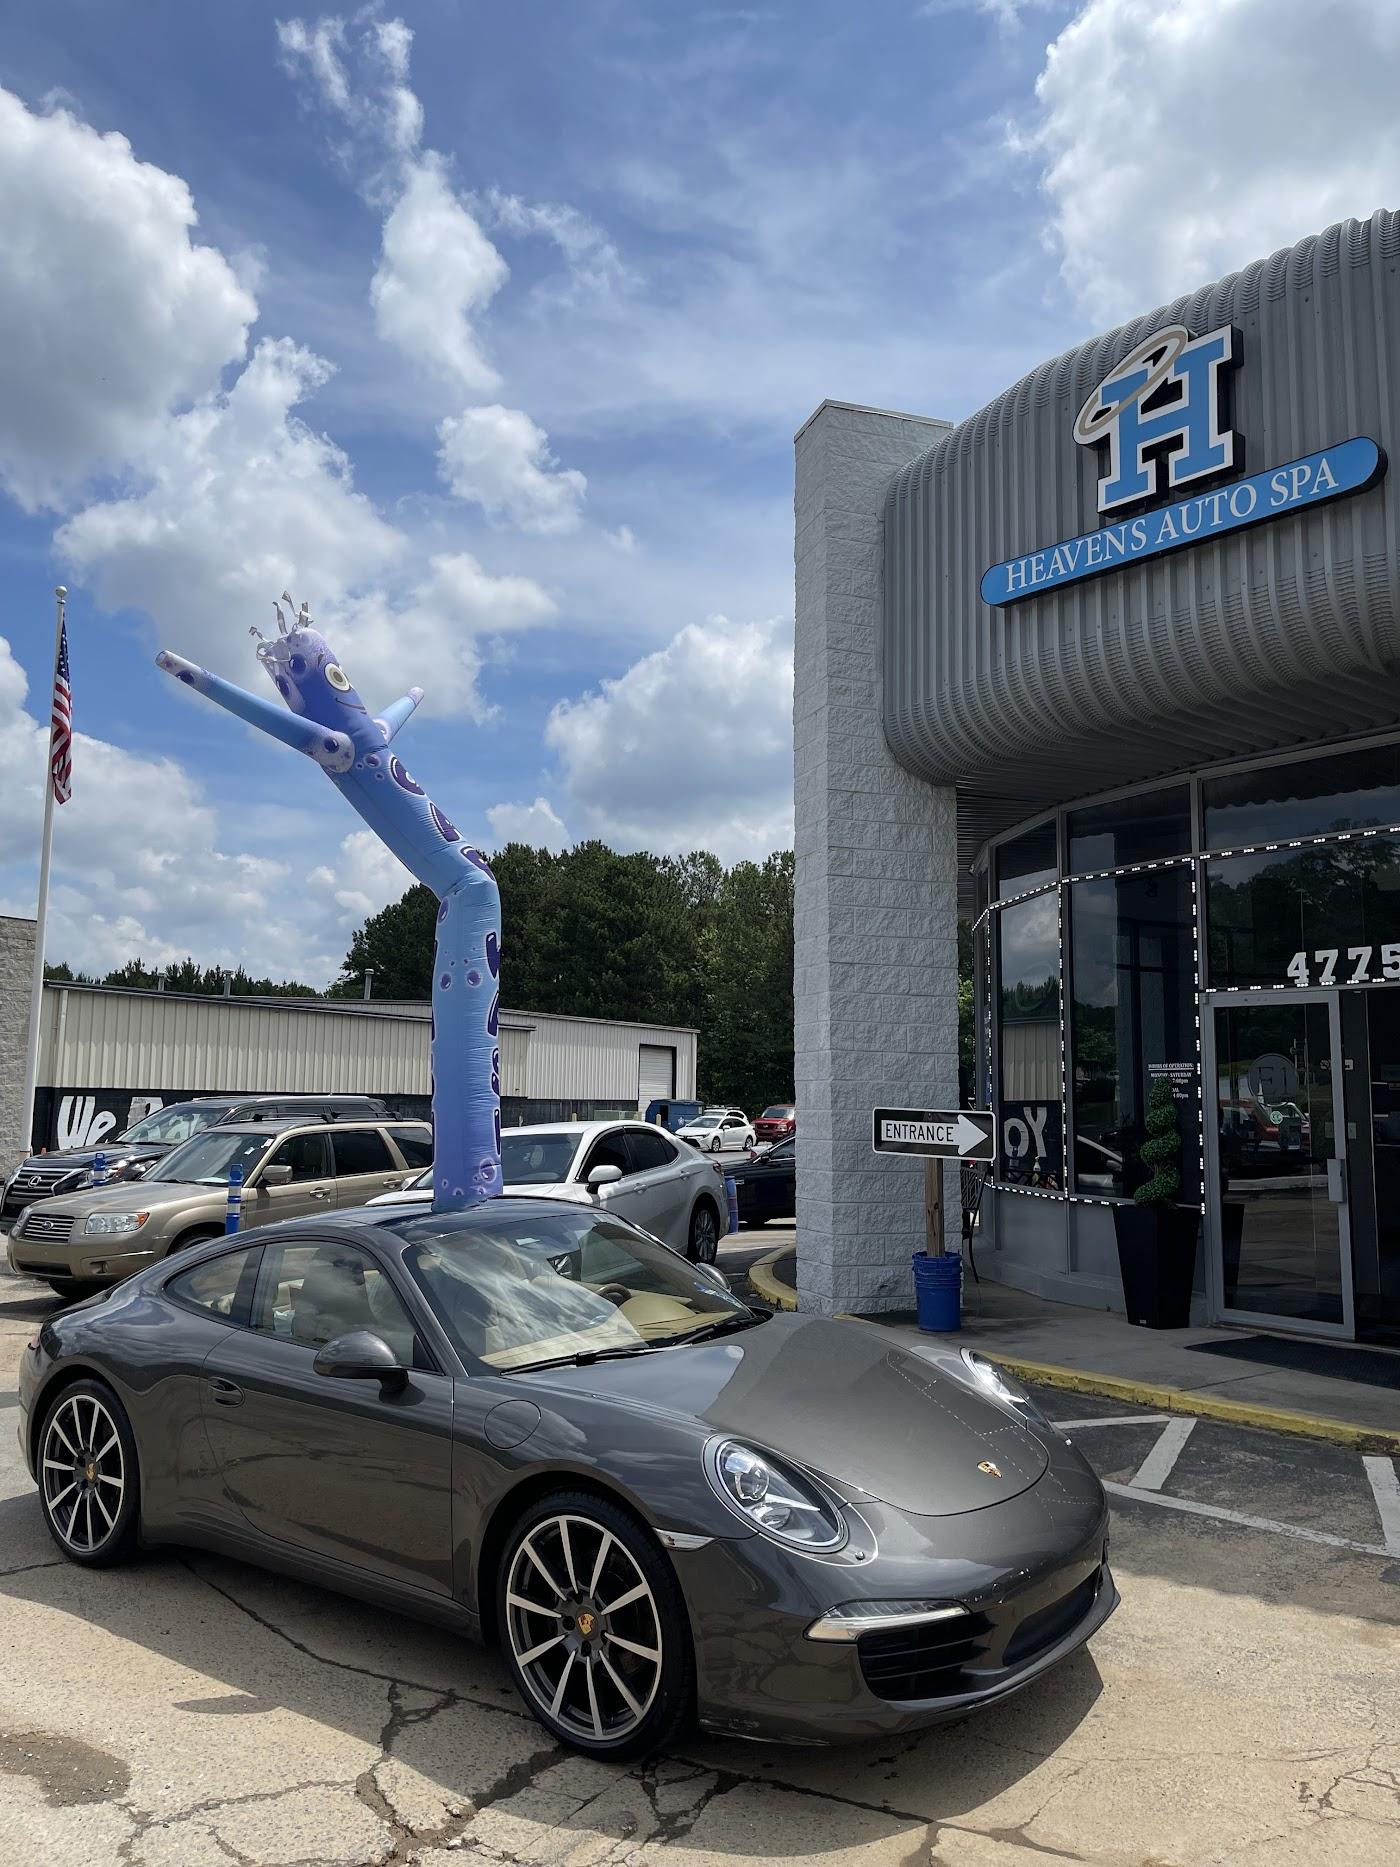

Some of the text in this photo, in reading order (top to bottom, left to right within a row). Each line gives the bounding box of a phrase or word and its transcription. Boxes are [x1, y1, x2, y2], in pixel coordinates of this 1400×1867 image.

[1005, 457, 1339, 593] HEAVENS AUTO SPA
[1287, 943, 1400, 985] 4775
[57, 1096, 117, 1150] We
[885, 1123, 954, 1142] ENTRANCE
